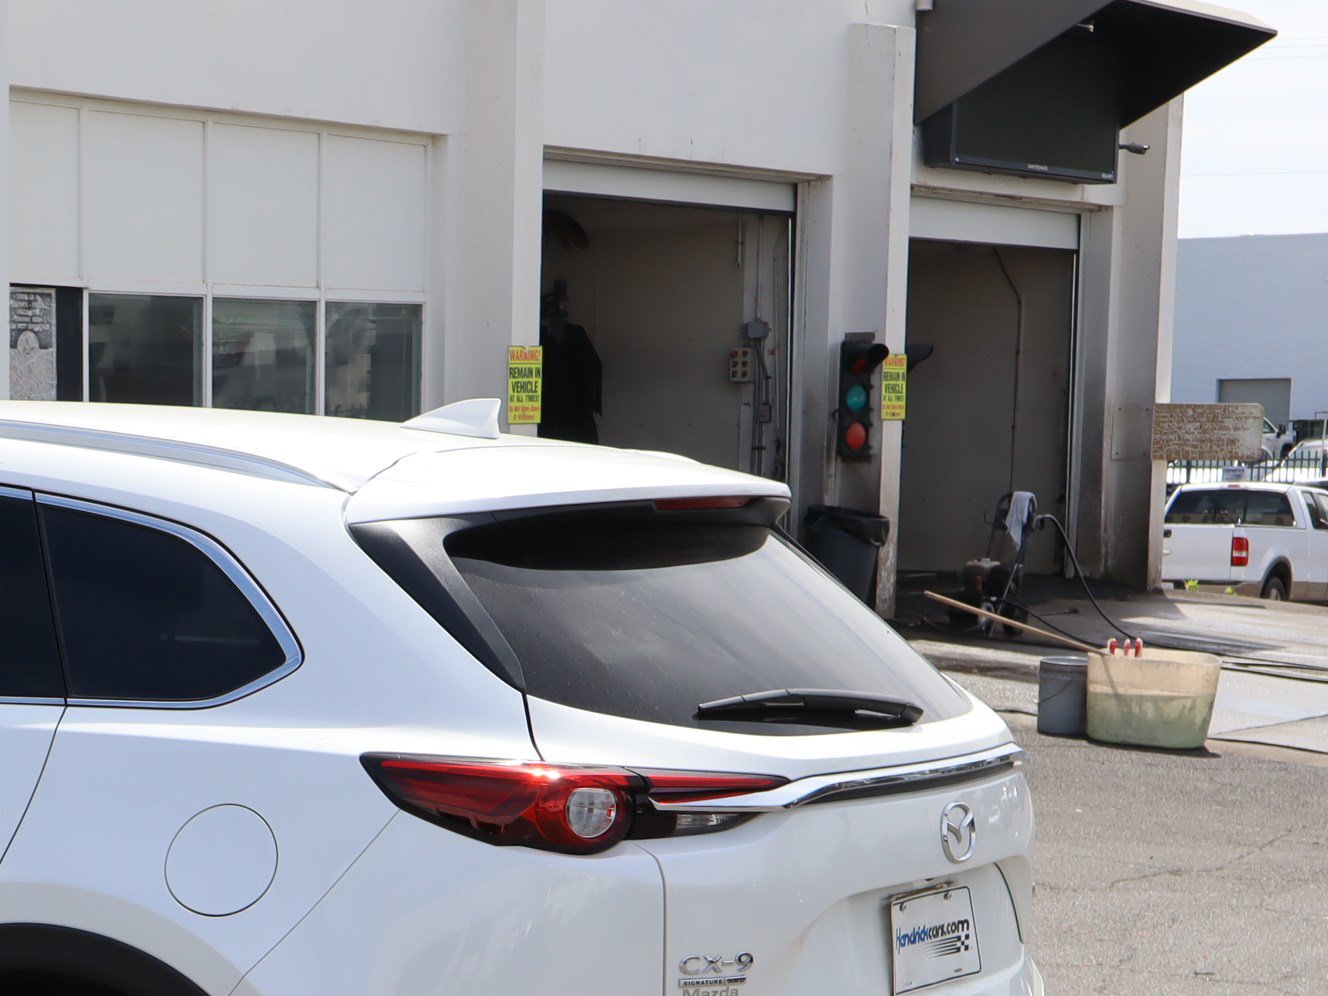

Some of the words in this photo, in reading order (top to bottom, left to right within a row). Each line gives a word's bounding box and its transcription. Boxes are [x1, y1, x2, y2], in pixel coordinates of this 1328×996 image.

[509, 349, 541, 361] WARNING!
[509, 367, 533, 379] REMAIN
[535, 367, 541, 379] IN
[512, 381, 538, 394] VEHICLE
[884, 383, 904, 394] VEHICLE
[510, 394, 515, 402] AT
[679, 951, 754, 976] CX-9
